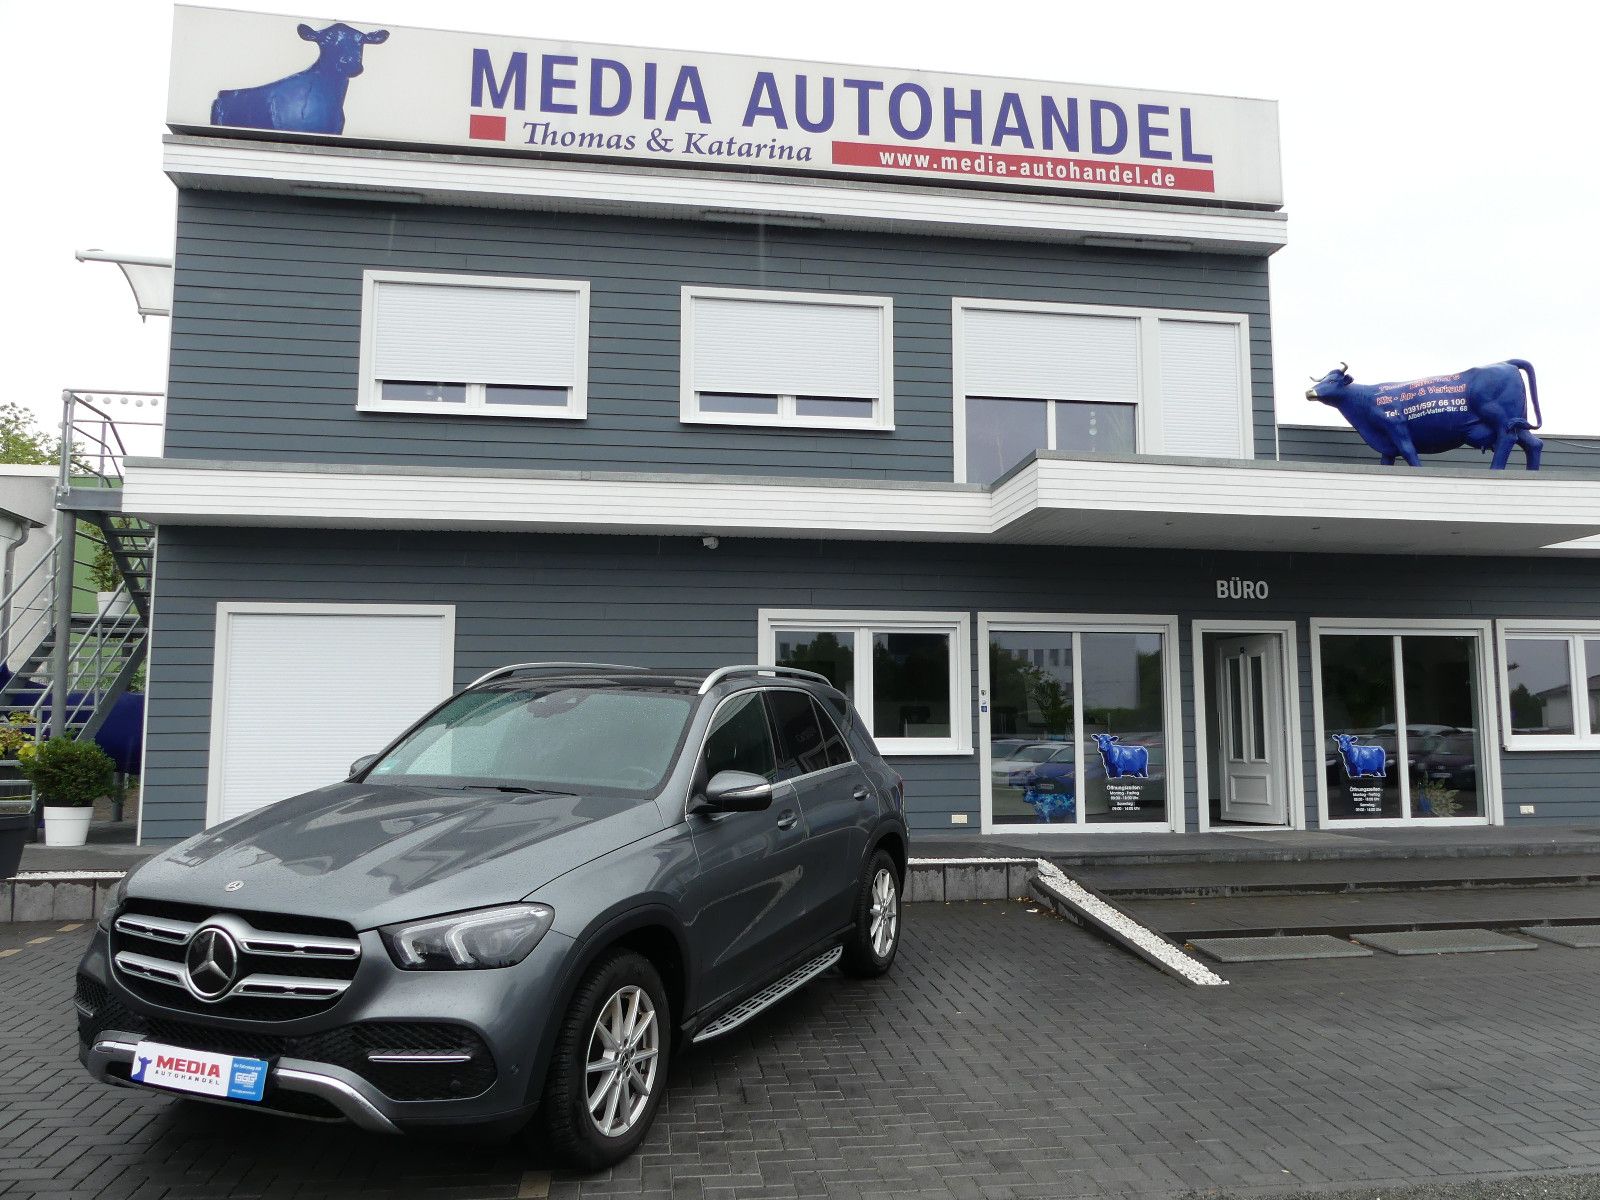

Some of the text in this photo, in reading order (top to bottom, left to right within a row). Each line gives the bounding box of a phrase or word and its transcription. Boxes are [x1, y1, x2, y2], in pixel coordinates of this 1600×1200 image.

[470, 48, 1213, 164] MEDIA AUTOHANDEL
[522, 121, 813, 162] Thomas & Katarina
[879, 150, 1176, 188] www.media-autohandel.de
[1385, 409, 1400, 417] Tel.
[1403, 400, 1436, 415] 0391/597
[1451, 398, 1466, 406] 100
[1408, 406, 1459, 420] Albert-Vater-Str.
[1216, 576, 1269, 599] BÜRO
[154, 1070, 220, 1086] AUTOHANDEL
[156, 1055, 220, 1078] MEDIA
